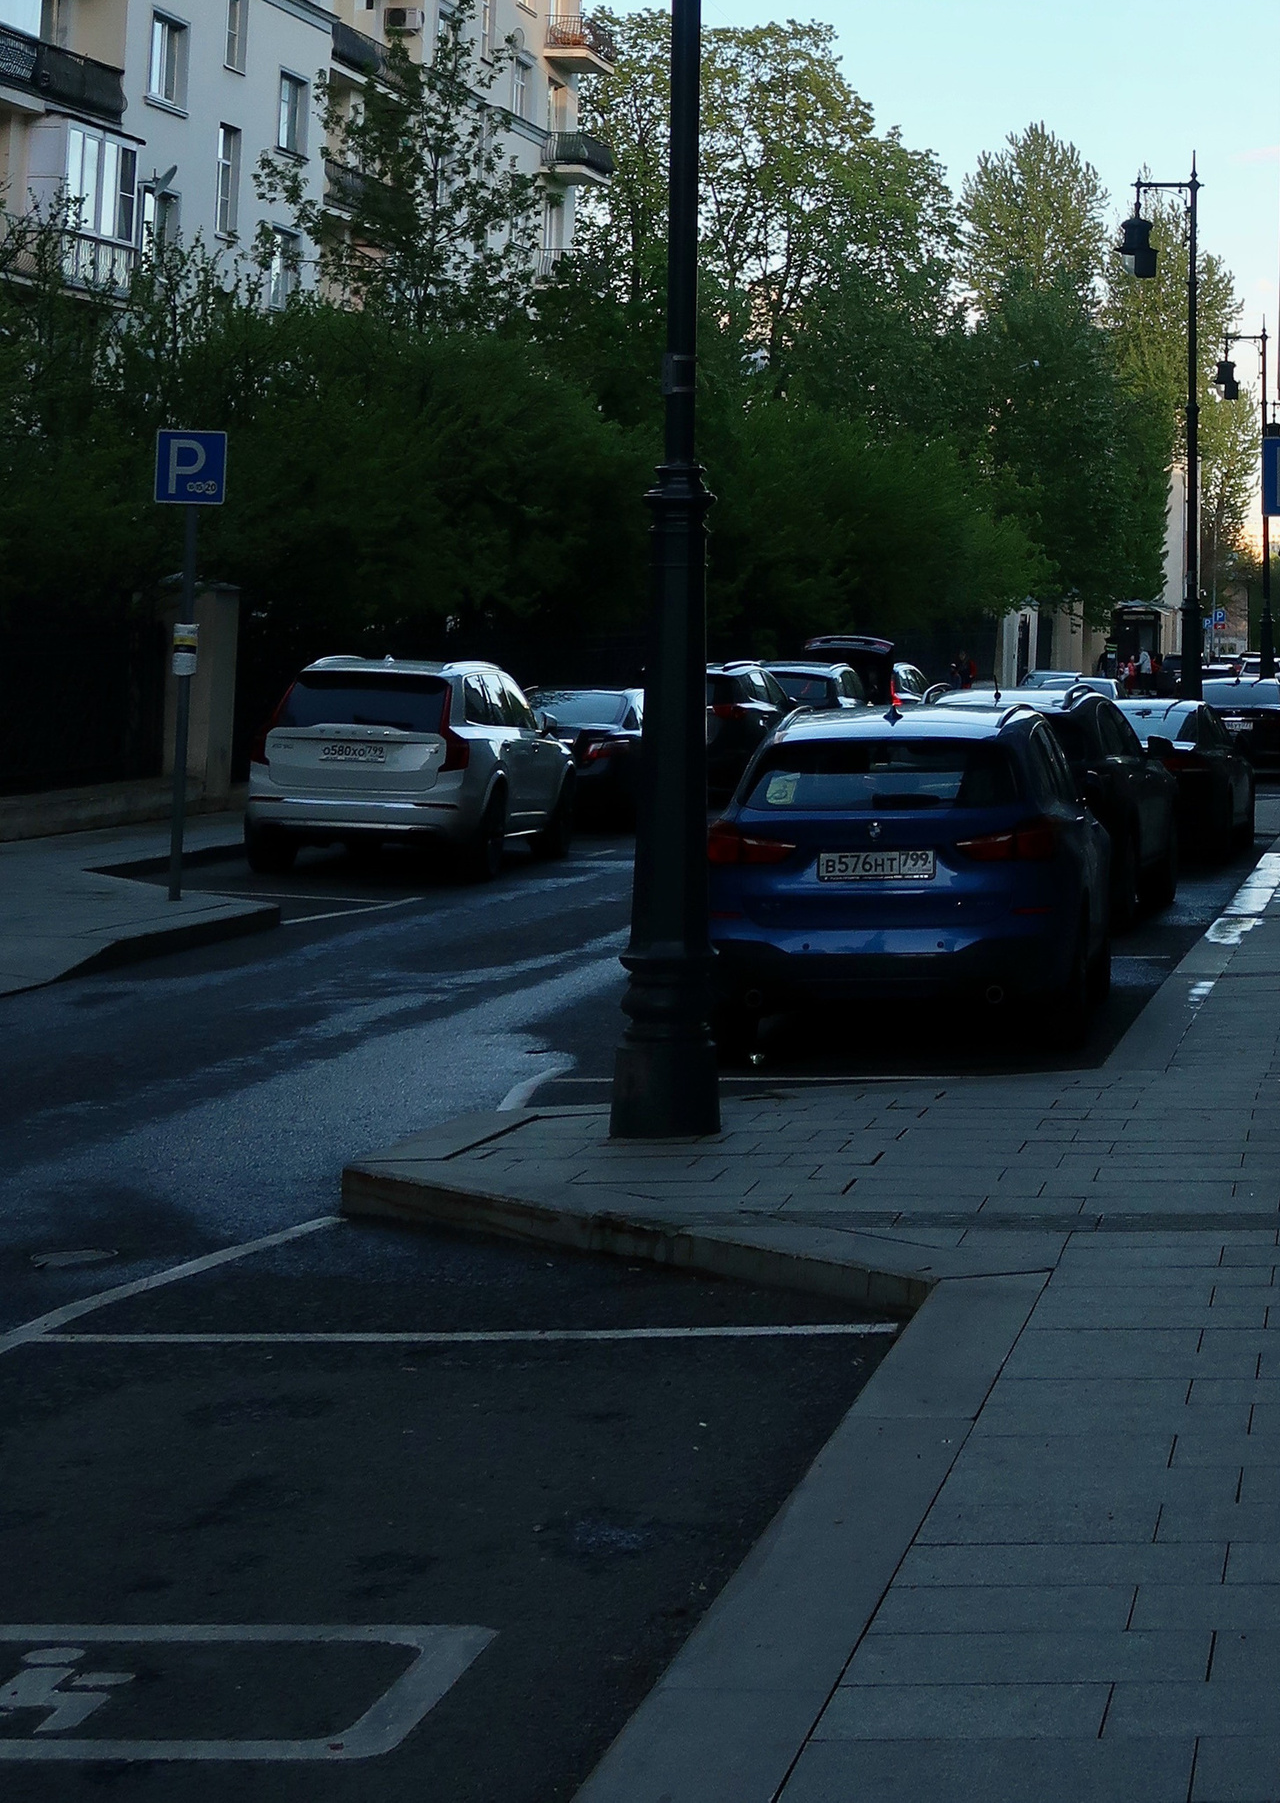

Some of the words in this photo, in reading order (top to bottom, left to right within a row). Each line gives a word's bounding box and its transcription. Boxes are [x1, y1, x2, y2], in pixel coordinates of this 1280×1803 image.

[168, 439, 206, 494] P
[205, 483, 217, 492] 20
[901, 852, 929, 867] 799
